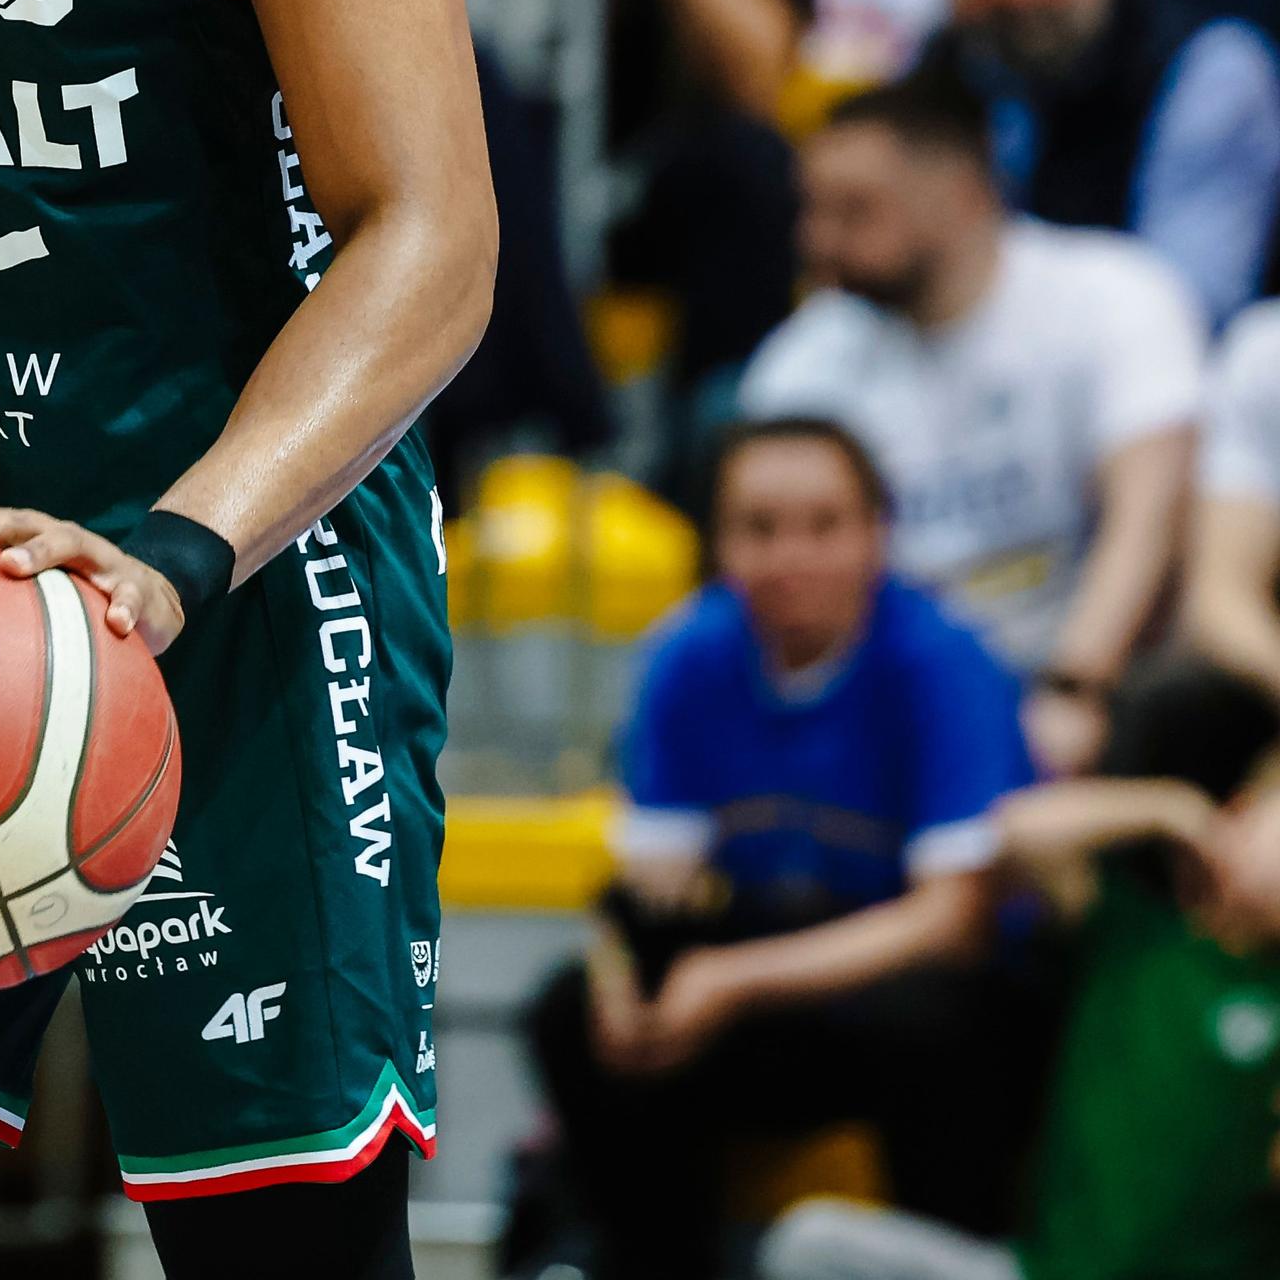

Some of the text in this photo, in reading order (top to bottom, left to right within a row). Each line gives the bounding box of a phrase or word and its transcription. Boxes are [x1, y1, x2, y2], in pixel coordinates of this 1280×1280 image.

[296, 519, 392, 888] ROCŁAW
[81, 900, 233, 965] quapark
[85, 950, 218, 983] wrocław
[201, 981, 287, 1044] 4F
